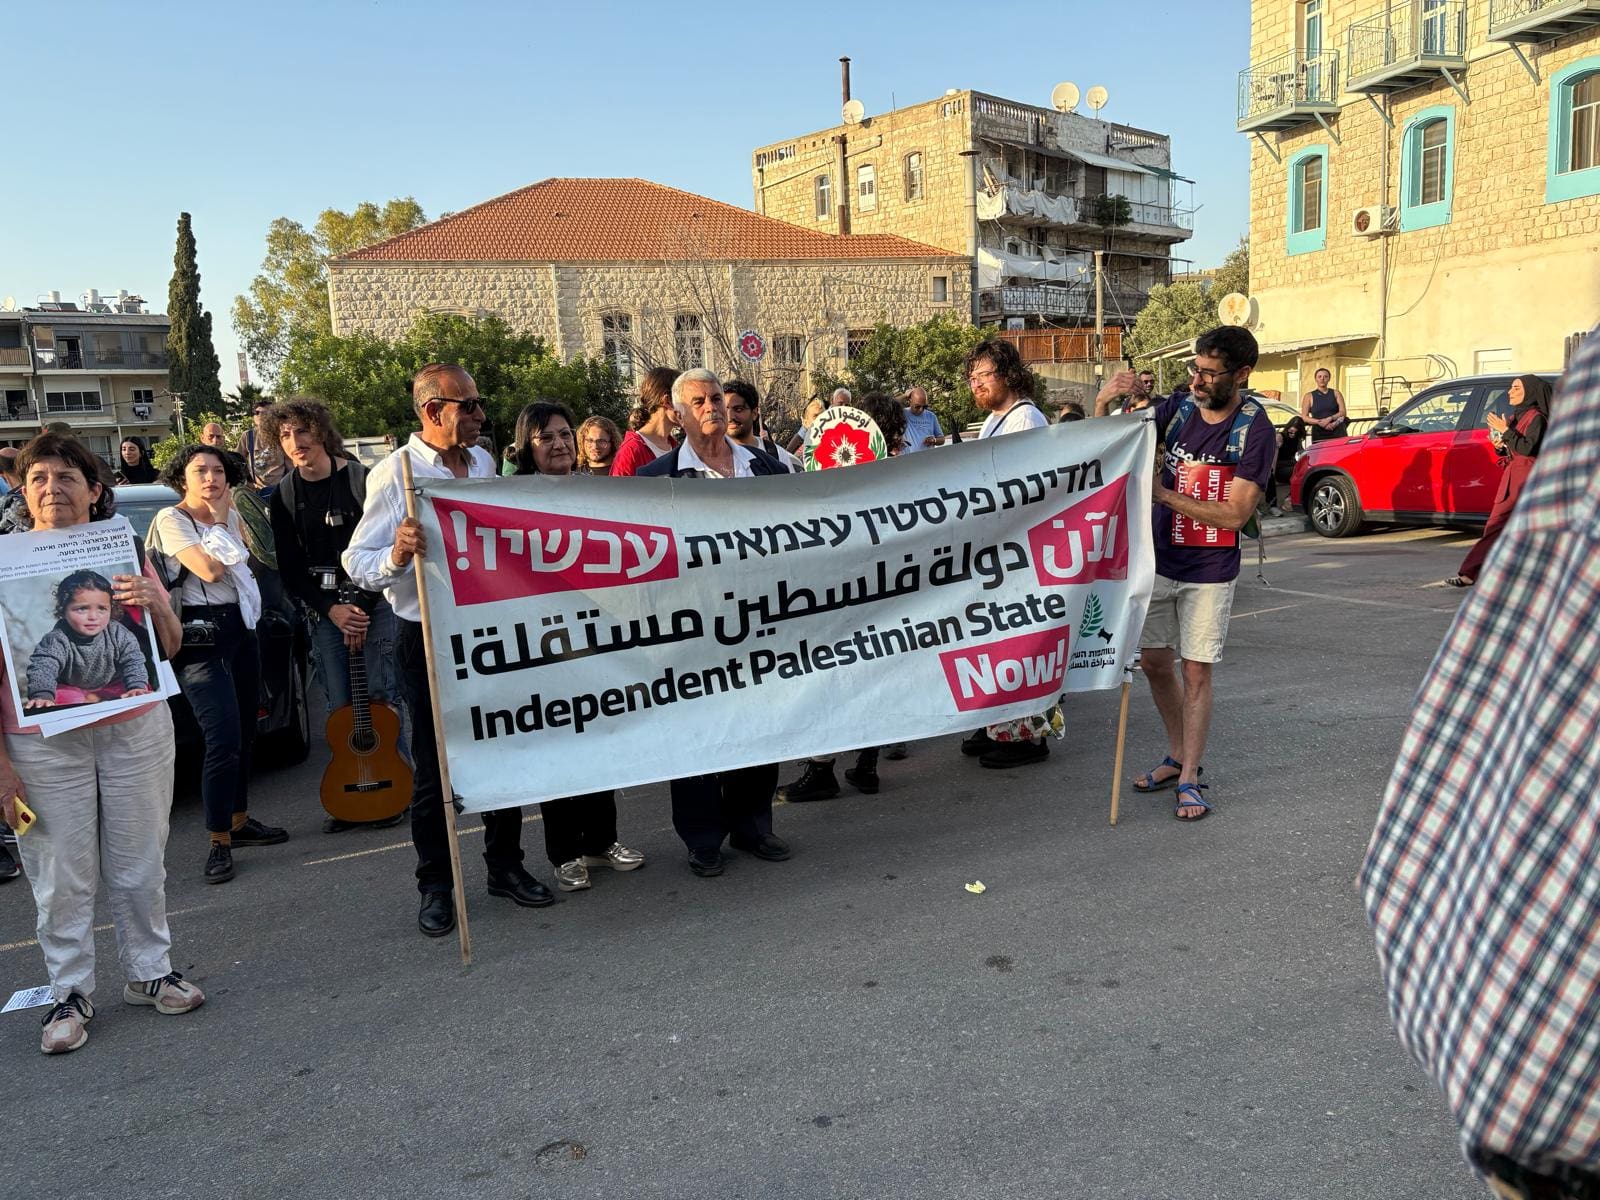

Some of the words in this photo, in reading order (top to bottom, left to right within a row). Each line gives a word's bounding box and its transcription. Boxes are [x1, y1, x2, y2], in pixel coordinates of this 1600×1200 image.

[996, 458, 1104, 511] מדינת
[102, 539, 130, 550] 20.3.25
[449, 509, 670, 580] עכשיו!
[684, 513, 852, 570] עצמאית
[855, 486, 996, 545] פלסטין
[1042, 511, 1119, 579] الآن
[928, 540, 1030, 590] دولة
[714, 553, 921, 646] فلسطين
[450, 607, 703, 681] مستقلة!
[470, 657, 747, 742] Independent
[749, 613, 964, 686] Palestinian
[964, 593, 1066, 637] State
[954, 638, 1066, 699] Now!
